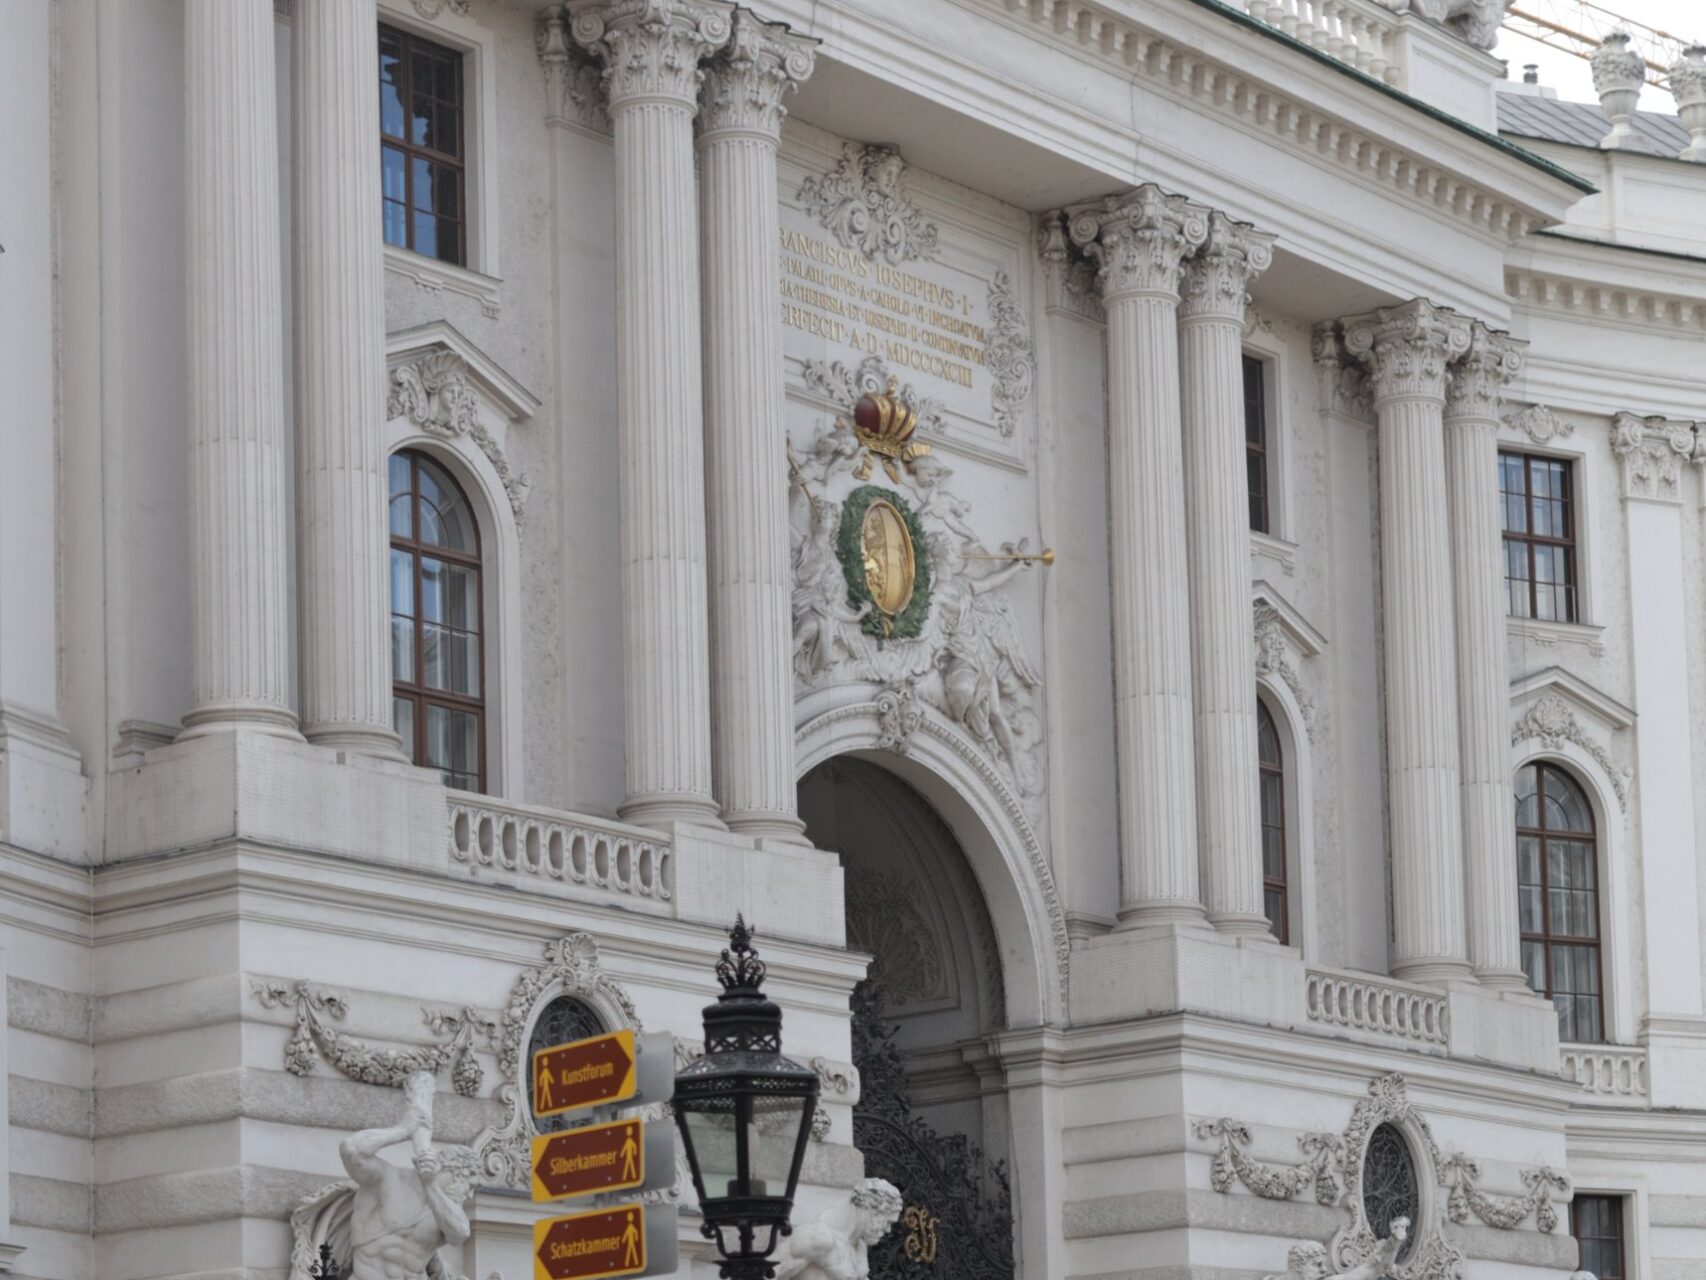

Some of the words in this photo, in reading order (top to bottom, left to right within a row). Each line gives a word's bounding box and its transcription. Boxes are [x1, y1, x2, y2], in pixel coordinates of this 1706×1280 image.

[561, 1061, 613, 1086] Kunstforum
[550, 1149, 617, 1177] Silberkammer
[551, 1235, 620, 1260] Schatzkammer
